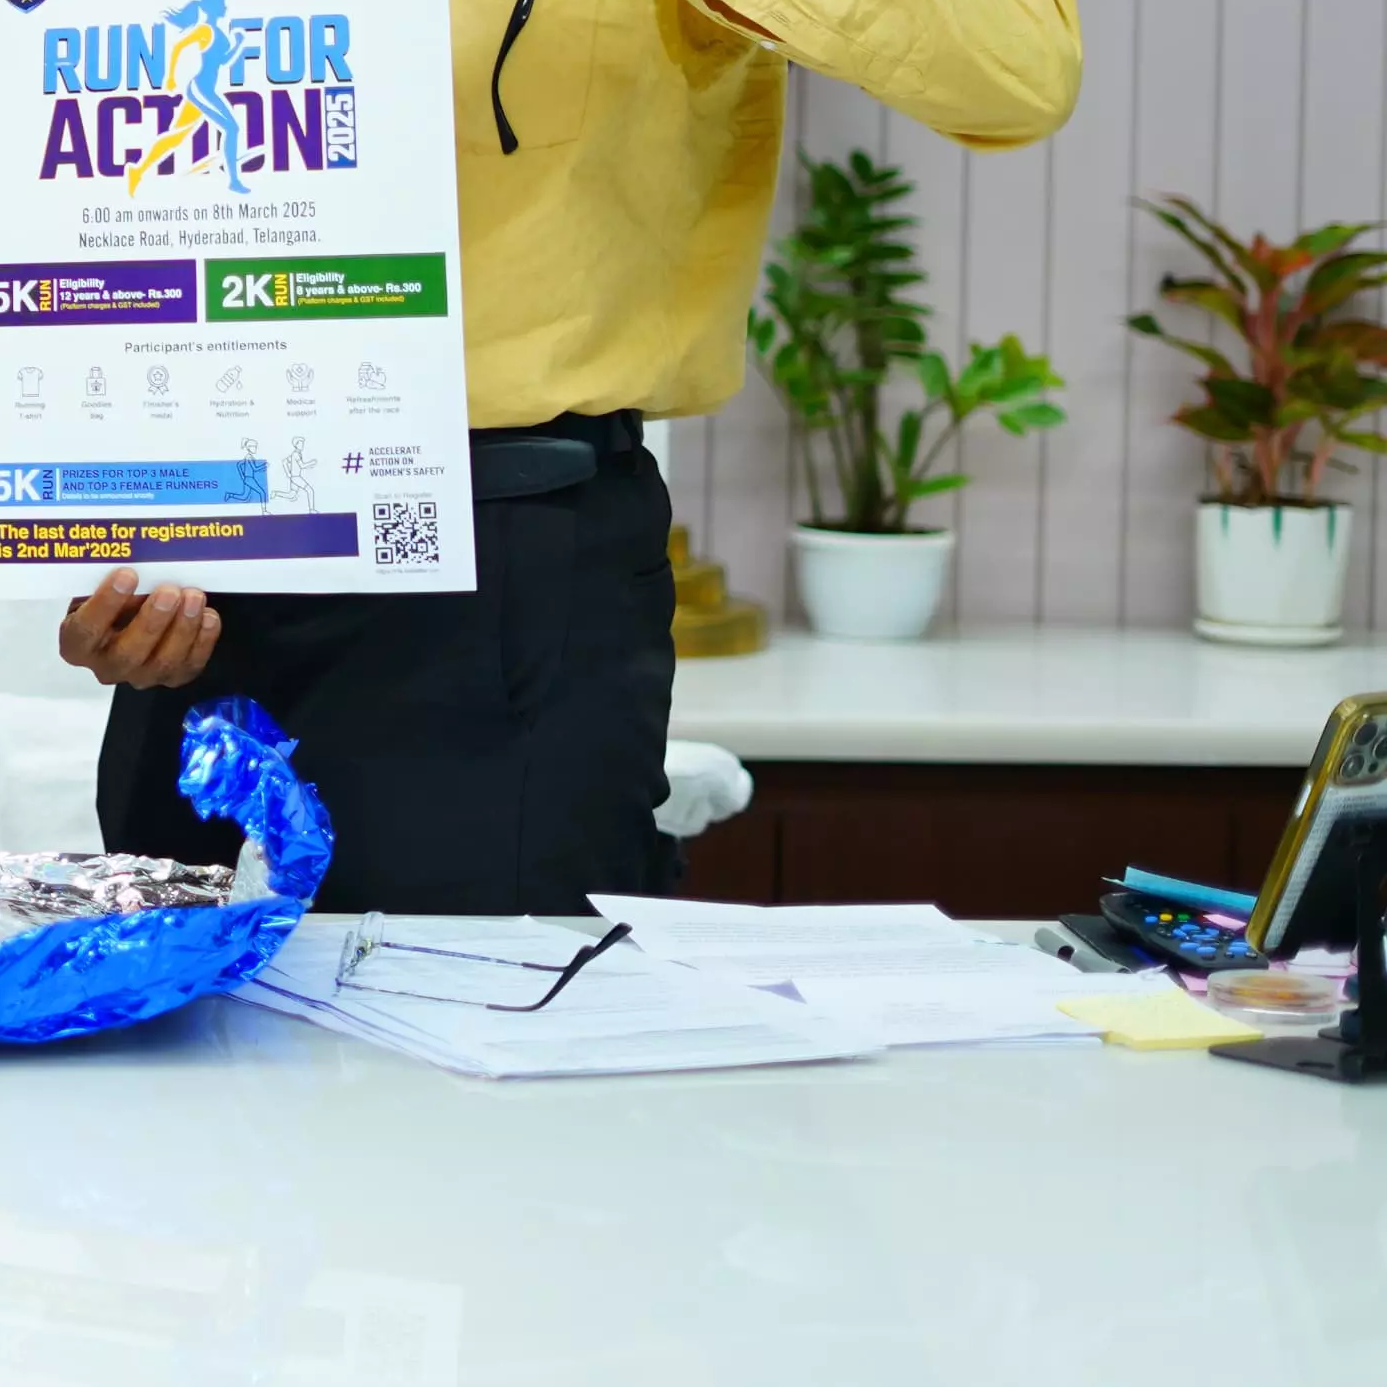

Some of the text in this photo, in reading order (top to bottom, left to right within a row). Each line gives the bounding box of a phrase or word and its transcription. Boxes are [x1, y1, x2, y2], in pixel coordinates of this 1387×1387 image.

[43, 14, 353, 94] RUN FOR
[327, 93, 356, 163] 2025
[82, 200, 315, 225] 6:00 am onwards on 8th March 2025
[79, 224, 320, 251] Necklace Road, Hyderabad, Telangana.
[40, 280, 51, 311] RUN
[60, 278, 104, 290] Eligibility
[60, 289, 182, 302] 12 years & above- Rs.300
[125, 339, 287, 355] Participant's entitlements
[43, 470, 53, 500] RUN
[33, 524, 64, 539] last
[69, 524, 106, 539] date
[111, 524, 135, 539] for
[141, 522, 243, 541] registration
[17, 543, 48, 558] 2nd
[55, 543, 131, 558] Mar'2025
